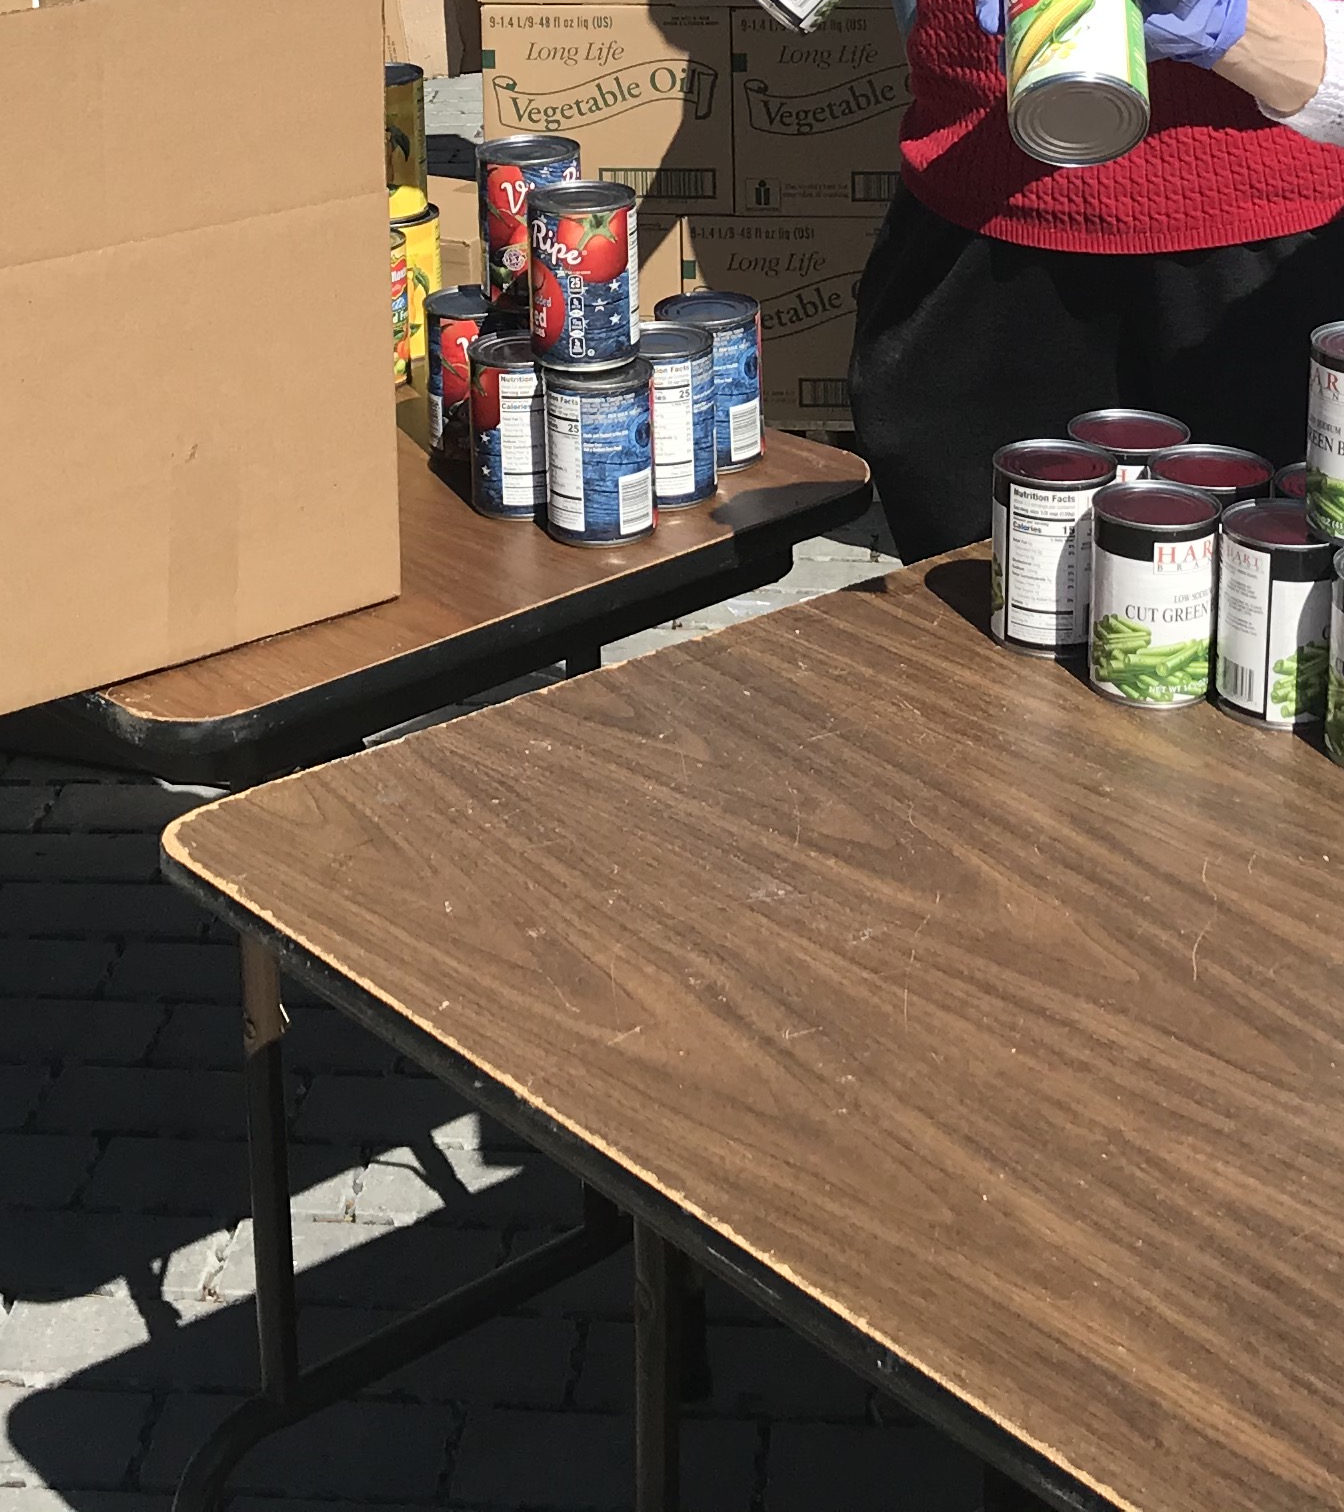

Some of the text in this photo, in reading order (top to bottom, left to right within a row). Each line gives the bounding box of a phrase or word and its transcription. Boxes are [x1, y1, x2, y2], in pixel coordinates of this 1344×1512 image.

[489, 15, 613, 31] 9-1.4 L/9-48 fl oz liq (US)
[525, 39, 625, 67] Long Life
[778, 43, 879, 70] Long Life
[509, 65, 697, 131] Vegetable Oil
[760, 78, 897, 134] Vegetable
[531, 219, 582, 266] Ripe
[727, 250, 826, 278] Long Life
[570, 276, 581, 289] 25
[670, 364, 690, 374] Facts
[500, 375, 534, 384] Nutrition
[560, 396, 579, 407] Facts
[679, 390, 690, 400] 25
[567, 423, 580, 434] 25
[1013, 488, 1076, 504] Nutrition Facts
[1012, 521, 1042, 534] Calories
[1124, 601, 1210, 624] CUT GREEN
